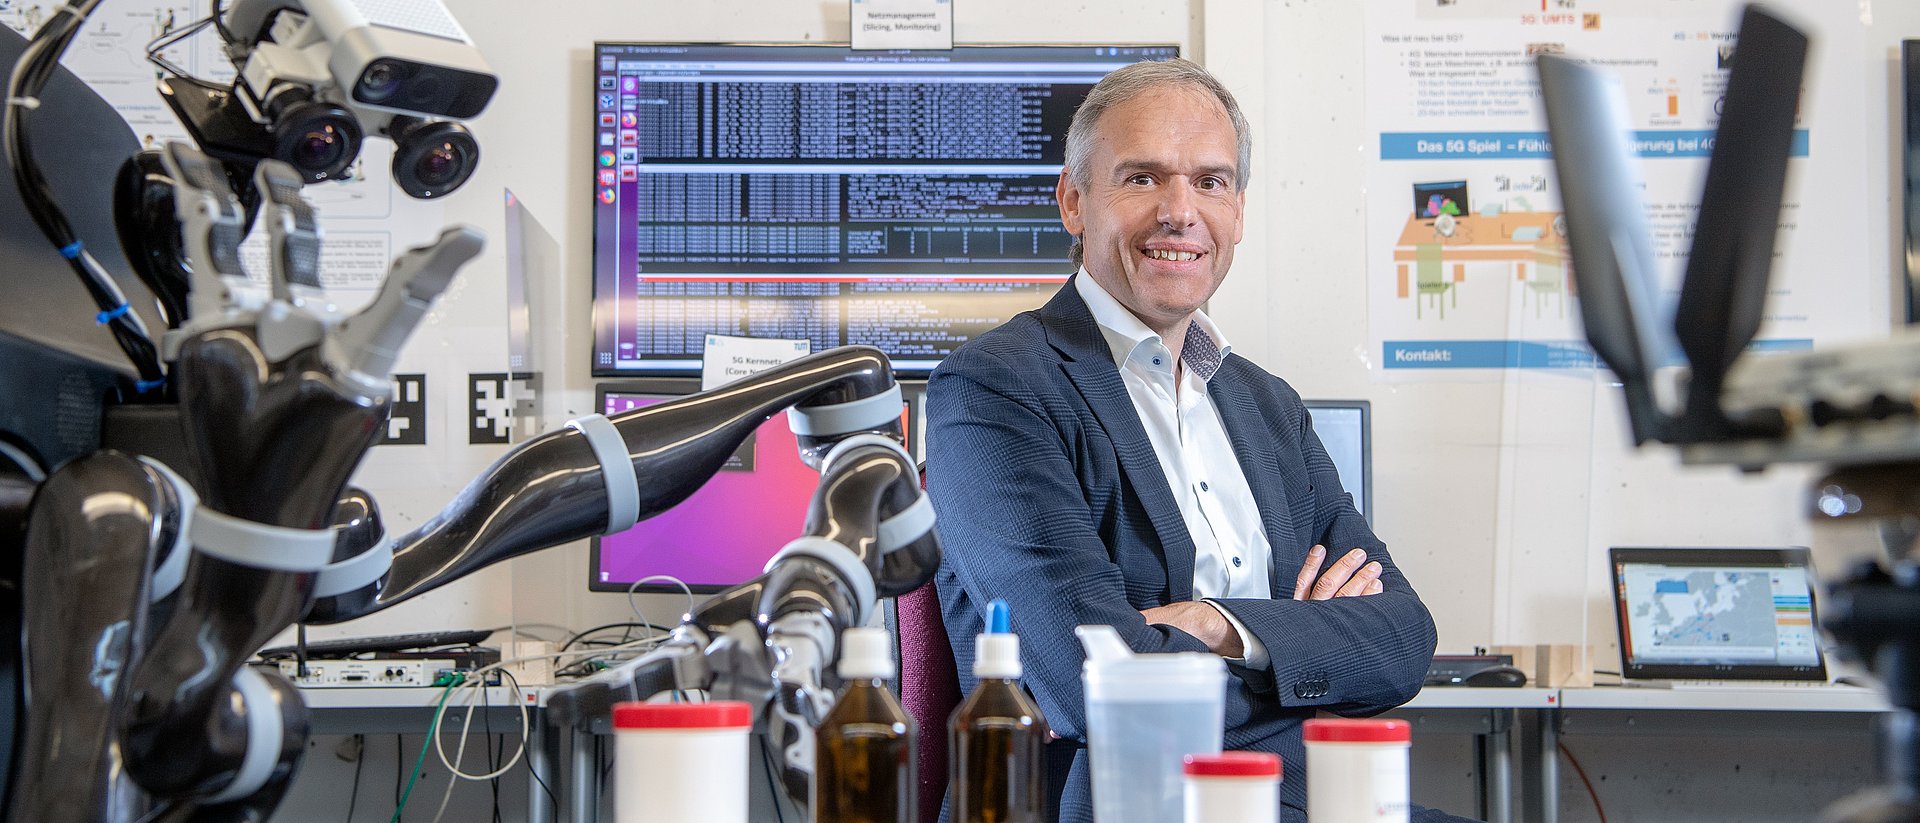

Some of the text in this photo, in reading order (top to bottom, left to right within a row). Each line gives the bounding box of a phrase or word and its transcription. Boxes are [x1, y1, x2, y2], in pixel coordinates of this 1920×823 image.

[867, 12, 936, 21] Netzmanagement
[1542, 15, 1576, 25] UMTS
[863, 24, 941, 32] (Slicing, Monitoring)
[1382, 35, 1400, 43] Was
[1417, 139, 1442, 153] Das
[1446, 139, 1465, 153] 5G
[1468, 138, 1501, 155] Spiel
[1677, 137, 1698, 152] bei
[1395, 349, 1451, 362] Kontakt:
[732, 356, 744, 365] 5G
[725, 367, 748, 376] (Core
